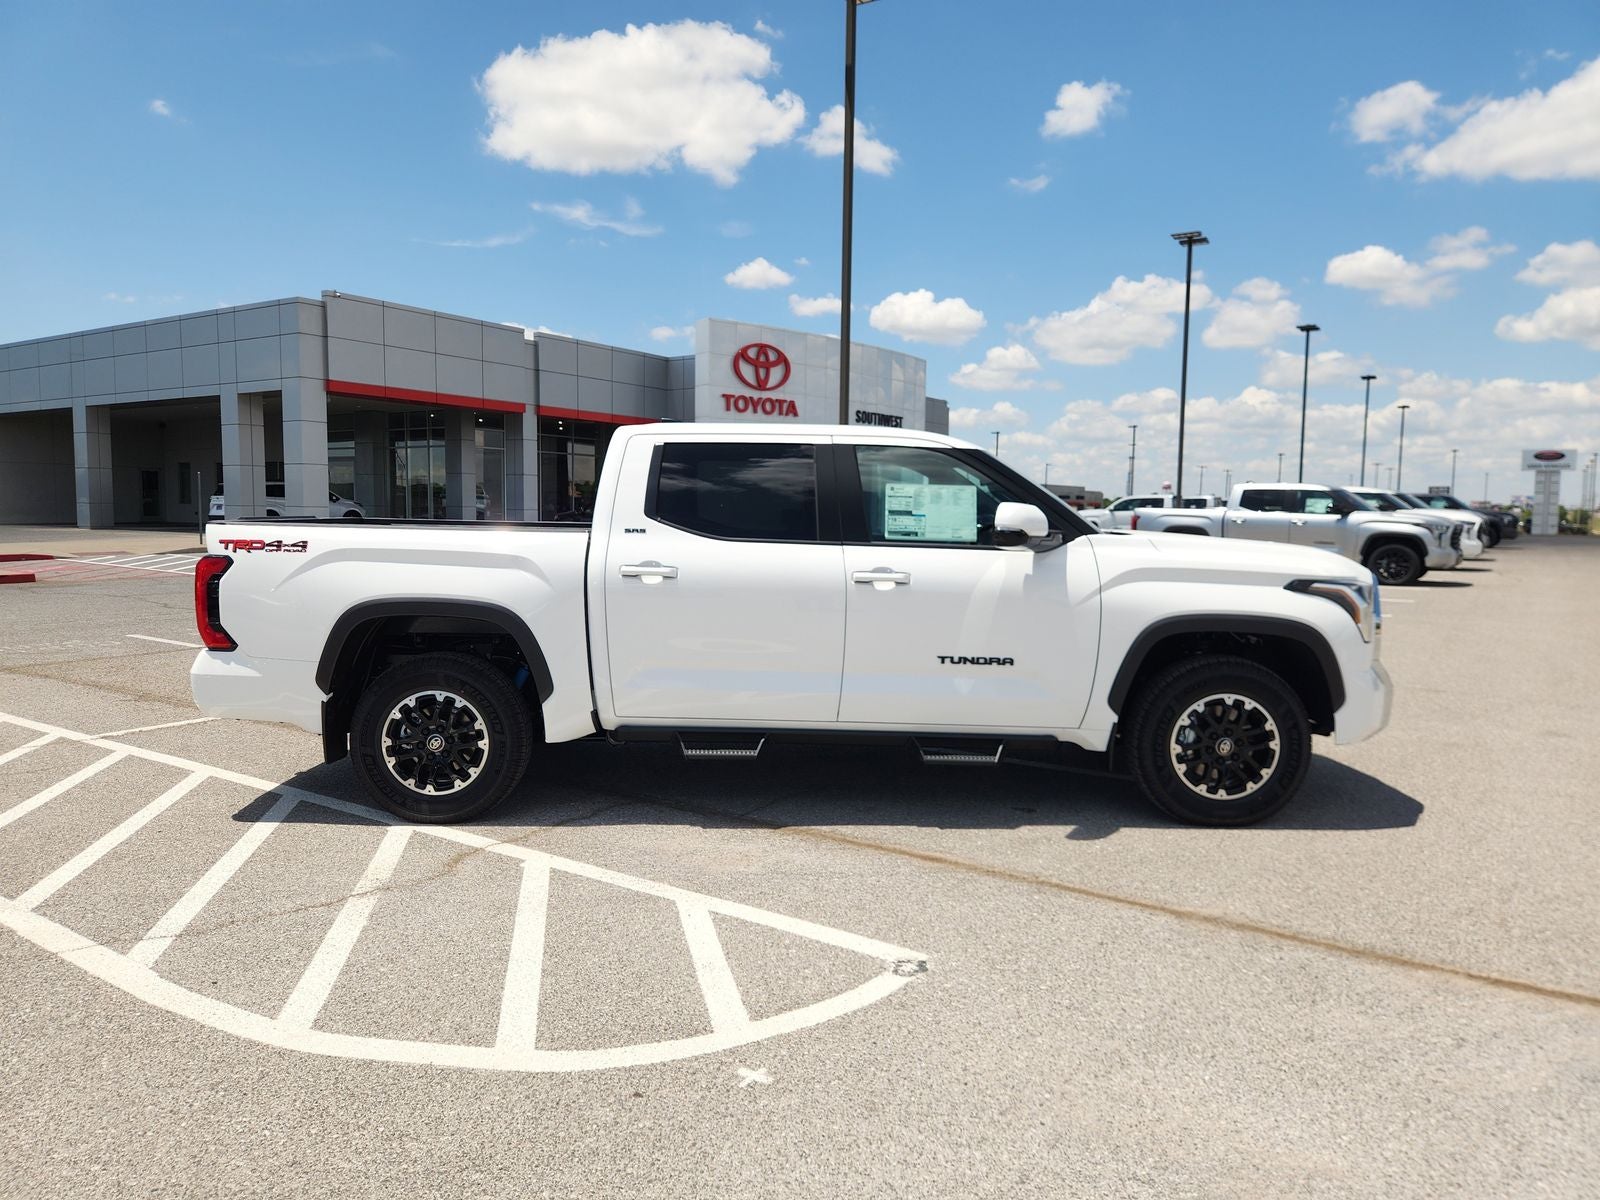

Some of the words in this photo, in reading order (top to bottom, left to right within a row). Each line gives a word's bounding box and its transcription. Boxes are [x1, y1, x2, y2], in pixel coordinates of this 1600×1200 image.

[722, 393, 799, 417] TOYOTA
[855, 409, 904, 428] SOUTHWEST
[219, 539, 265, 553] TRD
[936, 655, 1014, 666] TUNDRA
